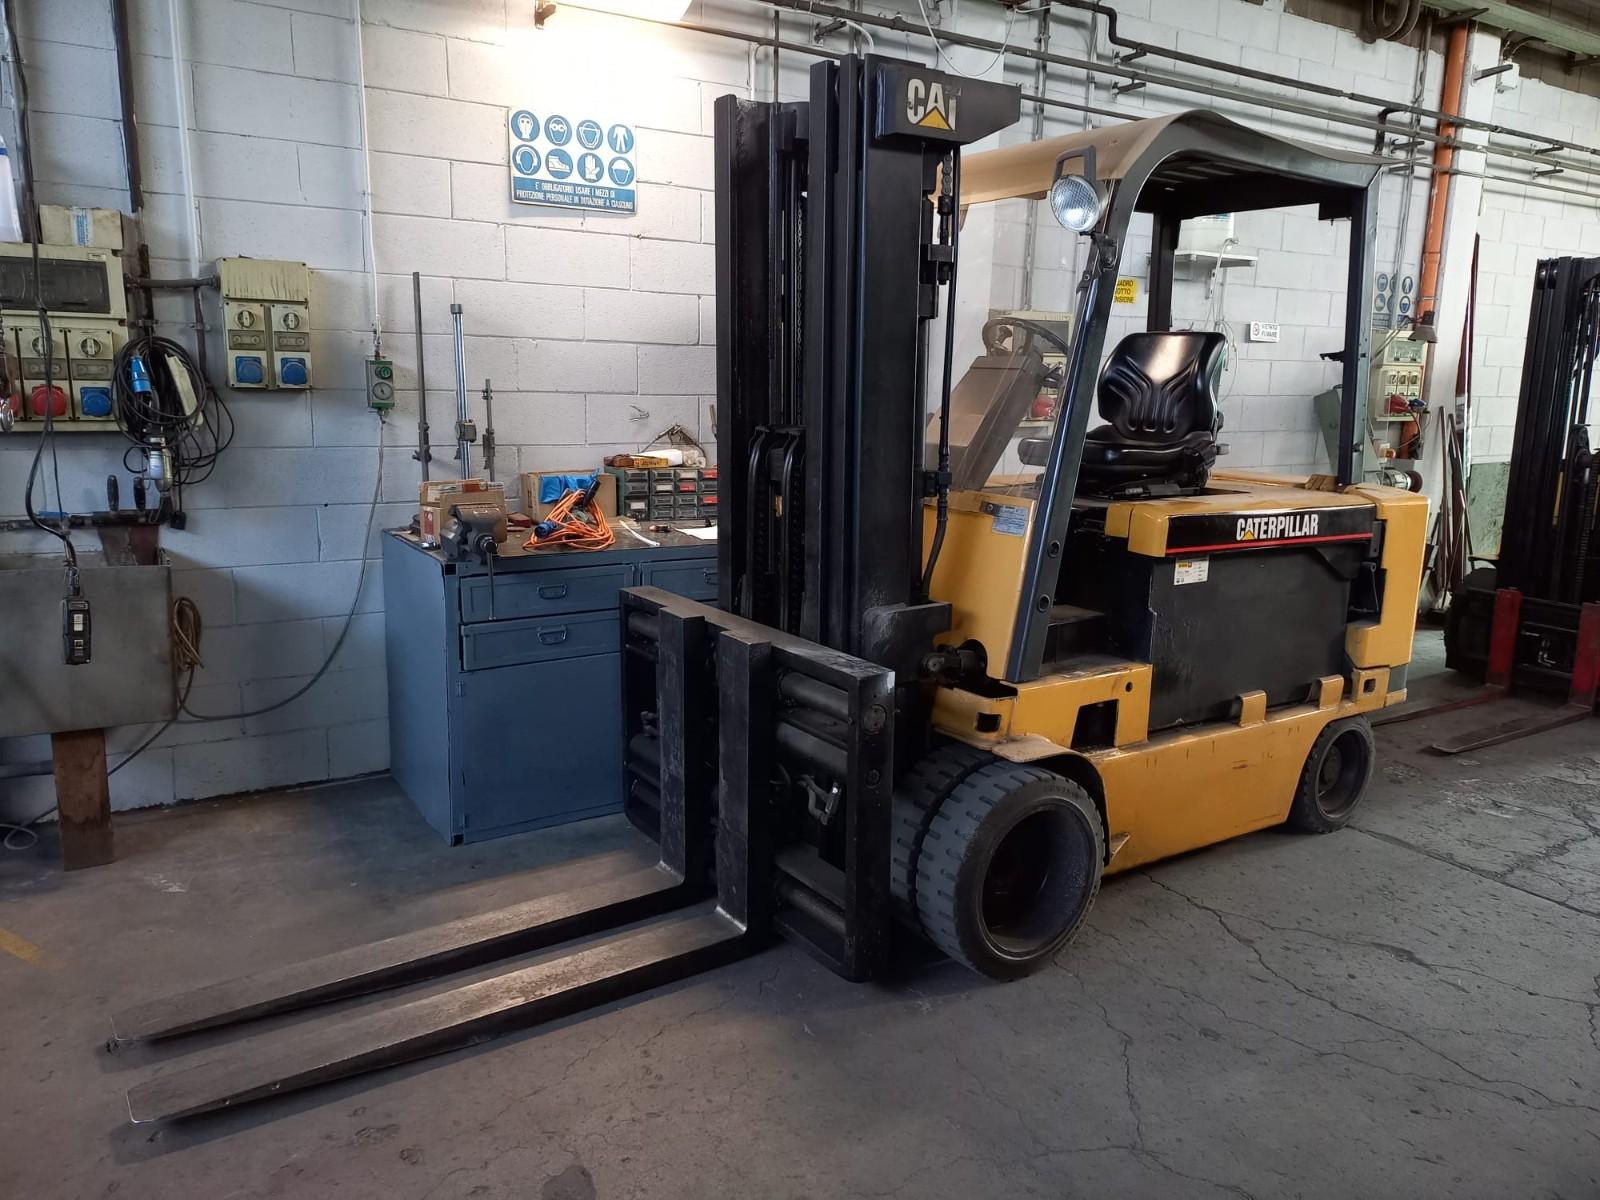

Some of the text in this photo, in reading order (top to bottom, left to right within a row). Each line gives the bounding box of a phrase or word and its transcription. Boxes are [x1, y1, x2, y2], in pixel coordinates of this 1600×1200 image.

[541, 182, 574, 193] OBBLIGATORIO
[575, 186, 590, 195] USARE
[595, 188, 609, 197] MEZZI
[516, 190, 544, 200] PROTEZIONE
[546, 192, 573, 203] PERSONALE
[580, 196, 605, 207] DOTAZIONE
[611, 200, 633, 209] CIASCUNO
[1236, 514, 1319, 541] CATERPILLAR
